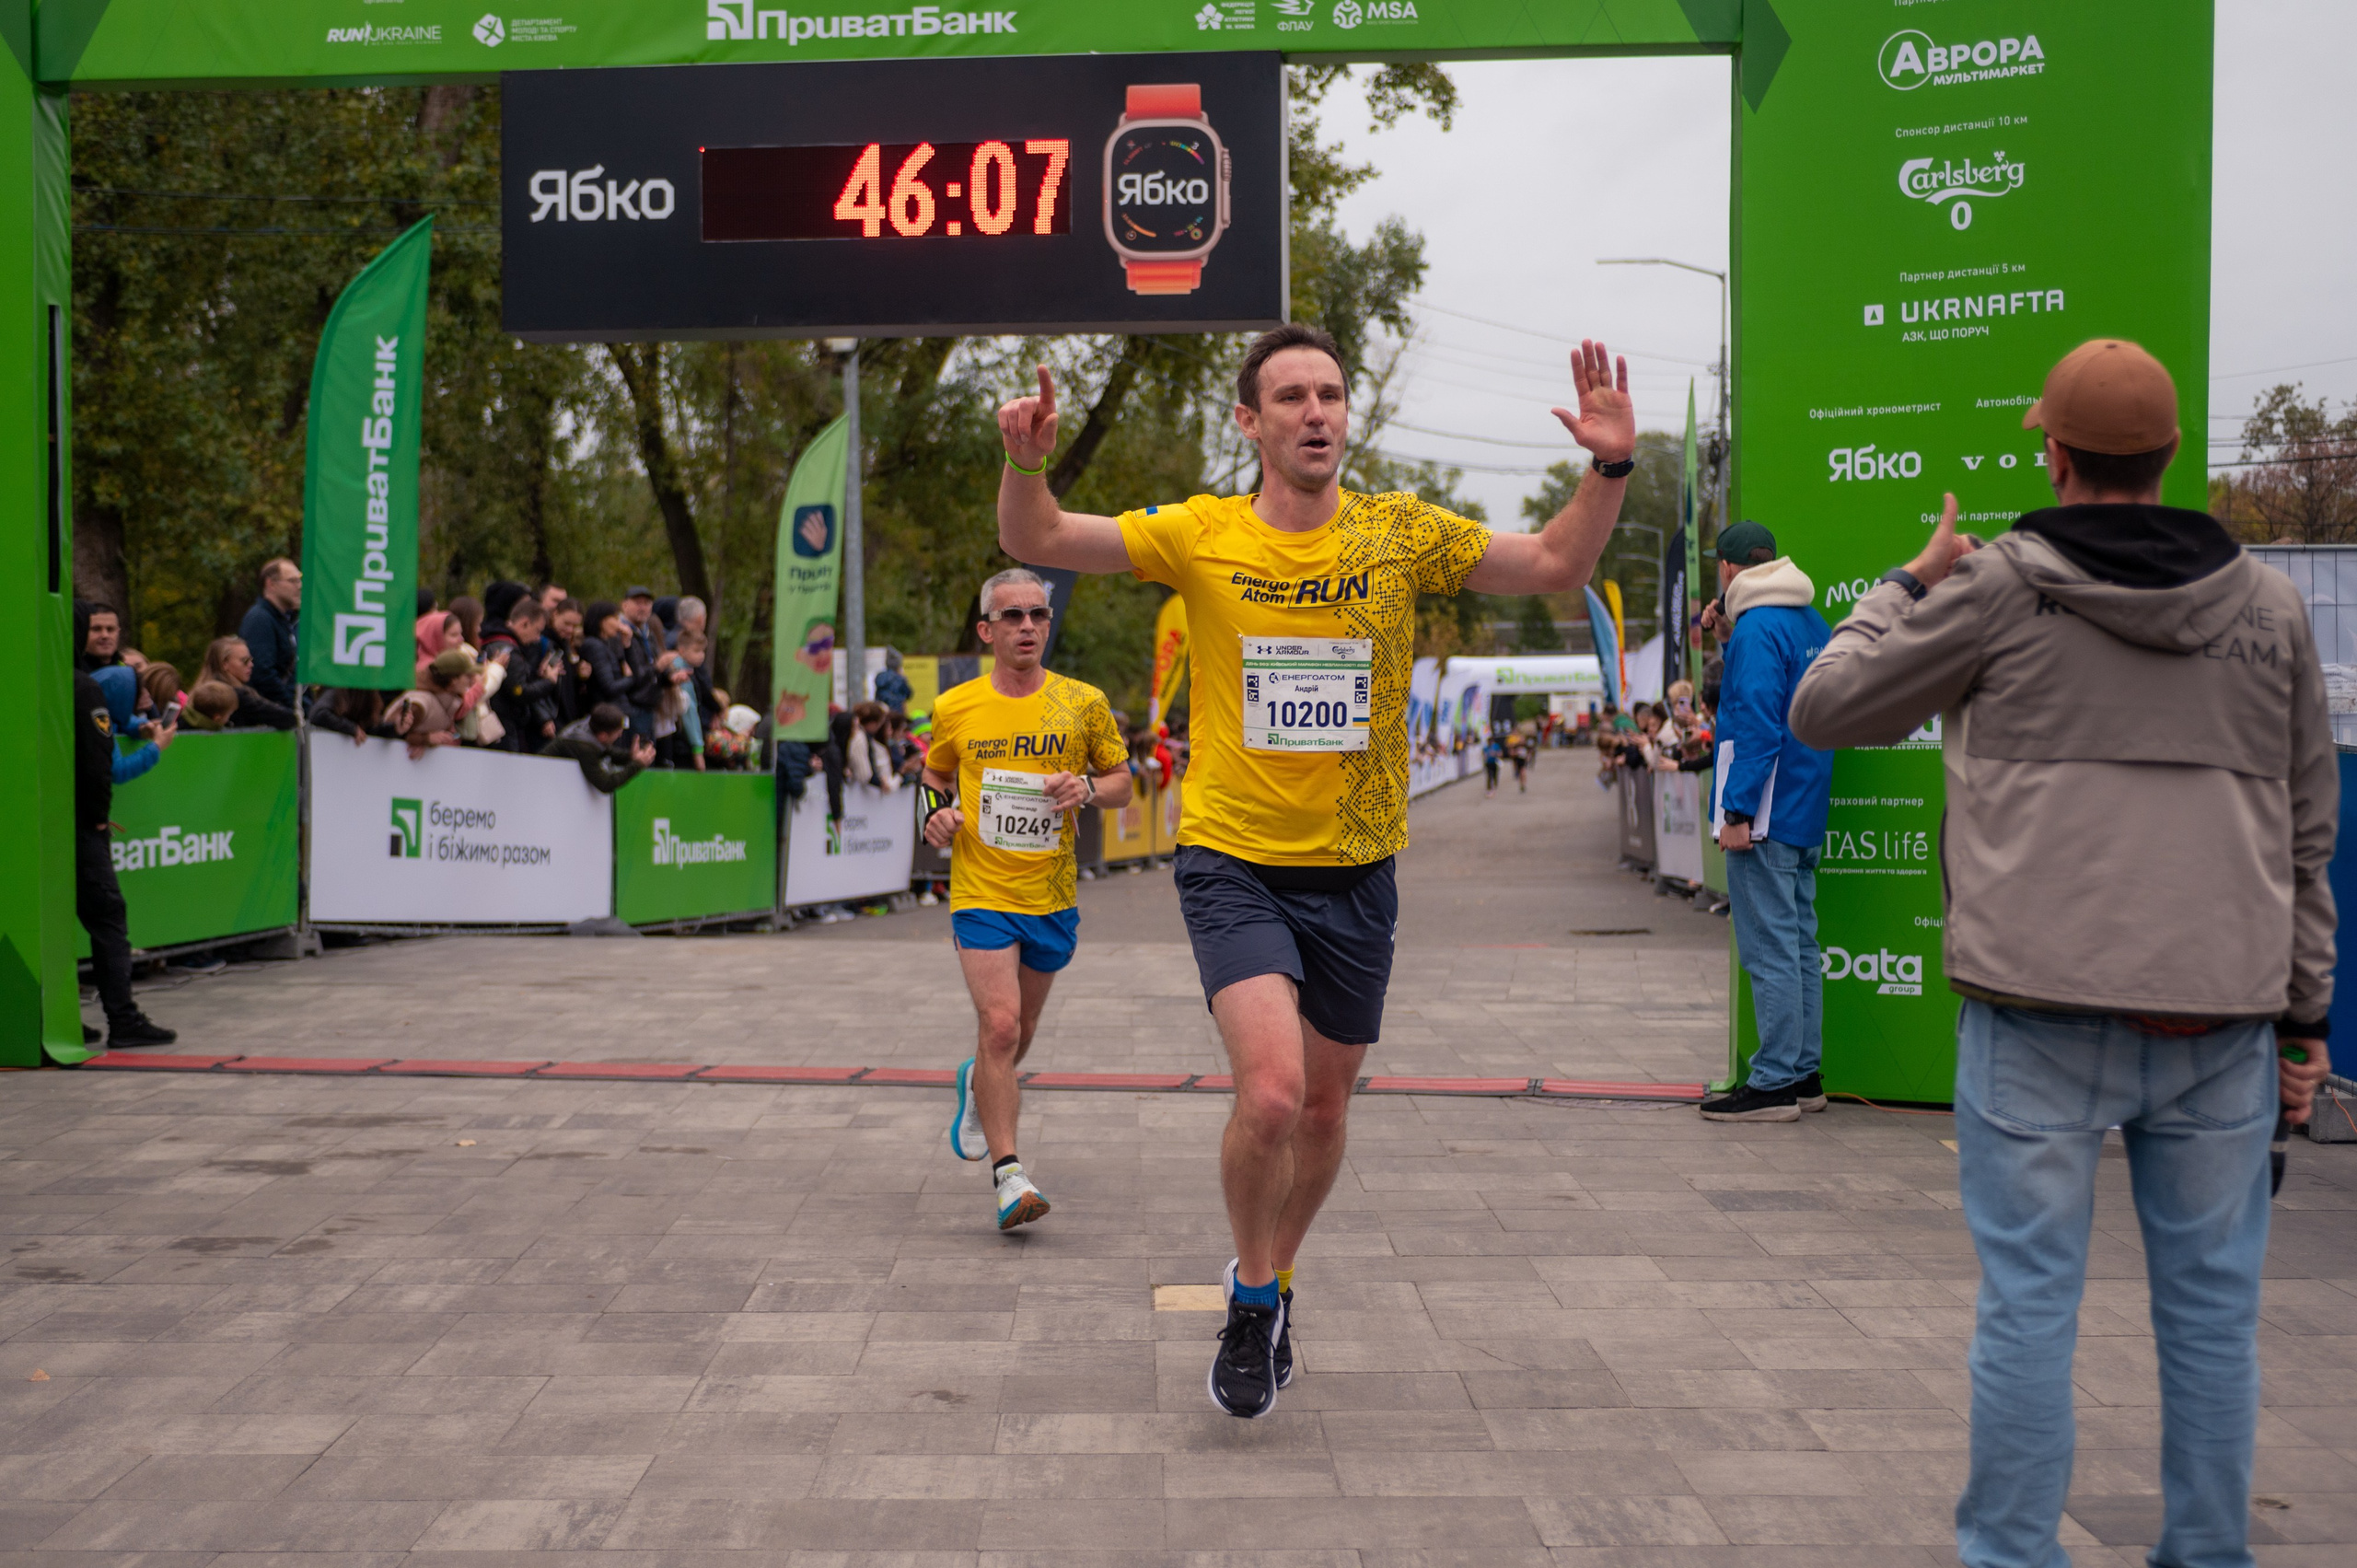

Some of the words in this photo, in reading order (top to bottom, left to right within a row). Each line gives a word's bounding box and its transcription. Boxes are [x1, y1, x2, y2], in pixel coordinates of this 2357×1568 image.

[1367, 1, 1419, 19] MSA
[757, 6, 1018, 46] ПриватБанк
[1277, 20, 1314, 31] ФЛАУ
[1933, 63, 2045, 86] МУЛЬТИМАРКЕТ
[1895, 125, 1940, 138] Спонсор
[1944, 117, 1995, 134] дистанції
[1999, 115, 2011, 126] 10
[2014, 116, 2027, 124] км
[832, 139, 1070, 238] 46:07
[1118, 169, 1209, 205] Ябко
[1898, 157, 2025, 200] Carlsberg
[530, 164, 675, 223] Ябко
[1951, 201, 1972, 230] 0
[1899, 271, 1945, 284] Партнер
[1947, 264, 1999, 280] дистанції
[2003, 263, 2008, 273] 5
[2012, 263, 2026, 273] км
[1901, 289, 2064, 323] UKRNAFTA
[1902, 331, 1927, 343] АЗК,
[1930, 329, 1949, 341] ЩО
[1952, 326, 1989, 339] ПОРУЧ
[1809, 405, 1864, 420] Офіційний
[1866, 402, 1941, 416] хронометрист
[1976, 396, 2043, 408] Автомобіль
[354, 335, 399, 612] ПриватБанк
[1829, 444, 1922, 482] Ябко
[1921, 511, 1967, 525] Офіні
[1969, 511, 2021, 523] партнери
[1231, 571, 1289, 592] Energo
[1295, 571, 1369, 605] RUN
[1240, 587, 1285, 604] Atom
[2203, 637, 2277, 669] EAM
[1295, 684, 1318, 693] Андрій
[1267, 701, 1347, 727] 10200
[968, 738, 1008, 750] Energo
[1014, 733, 1067, 757] RUN
[1280, 738, 1343, 747] ПриватБанк
[975, 749, 1006, 760] Atom
[1829, 796, 1877, 807] траховий
[1881, 797, 1923, 807] партнер
[430, 800, 496, 832] беремо
[996, 815, 1051, 836] 10249
[110, 826, 234, 872] ватБанк
[429, 833, 434, 860] і
[439, 835, 499, 863] біжимо
[503, 844, 551, 869] разом
[669, 835, 747, 868] ПриватБанк
[1823, 830, 1876, 860] TAS
[1915, 916, 1945, 928] Офіці
[1888, 985, 1915, 993] group
